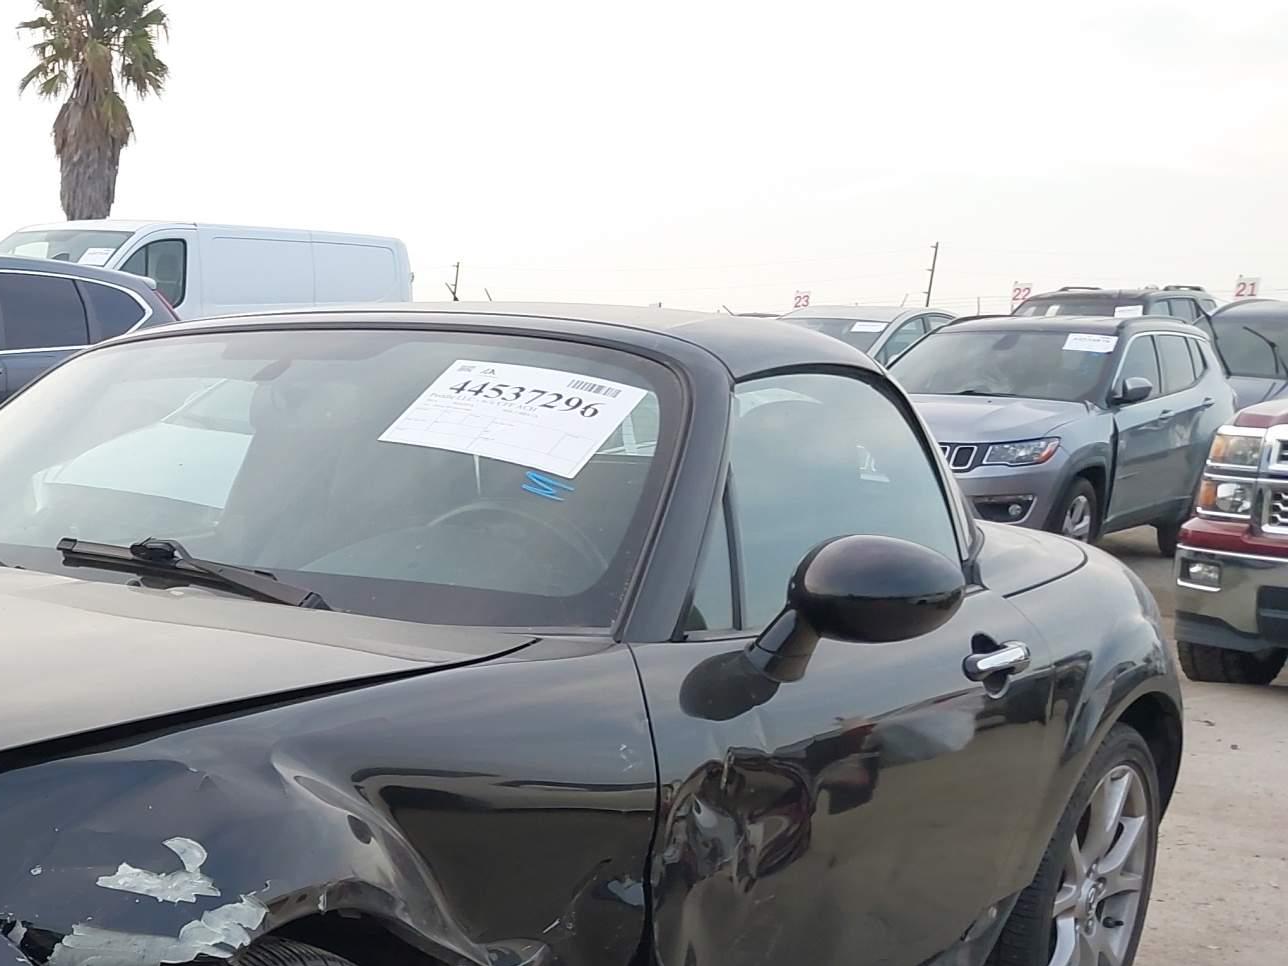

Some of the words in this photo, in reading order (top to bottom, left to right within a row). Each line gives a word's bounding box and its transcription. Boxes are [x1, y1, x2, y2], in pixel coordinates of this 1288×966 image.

[1012, 287, 1031, 300] 22
[1235, 282, 1256, 296] 21
[794, 295, 809, 308] 23
[449, 380, 607, 417] 44537296
